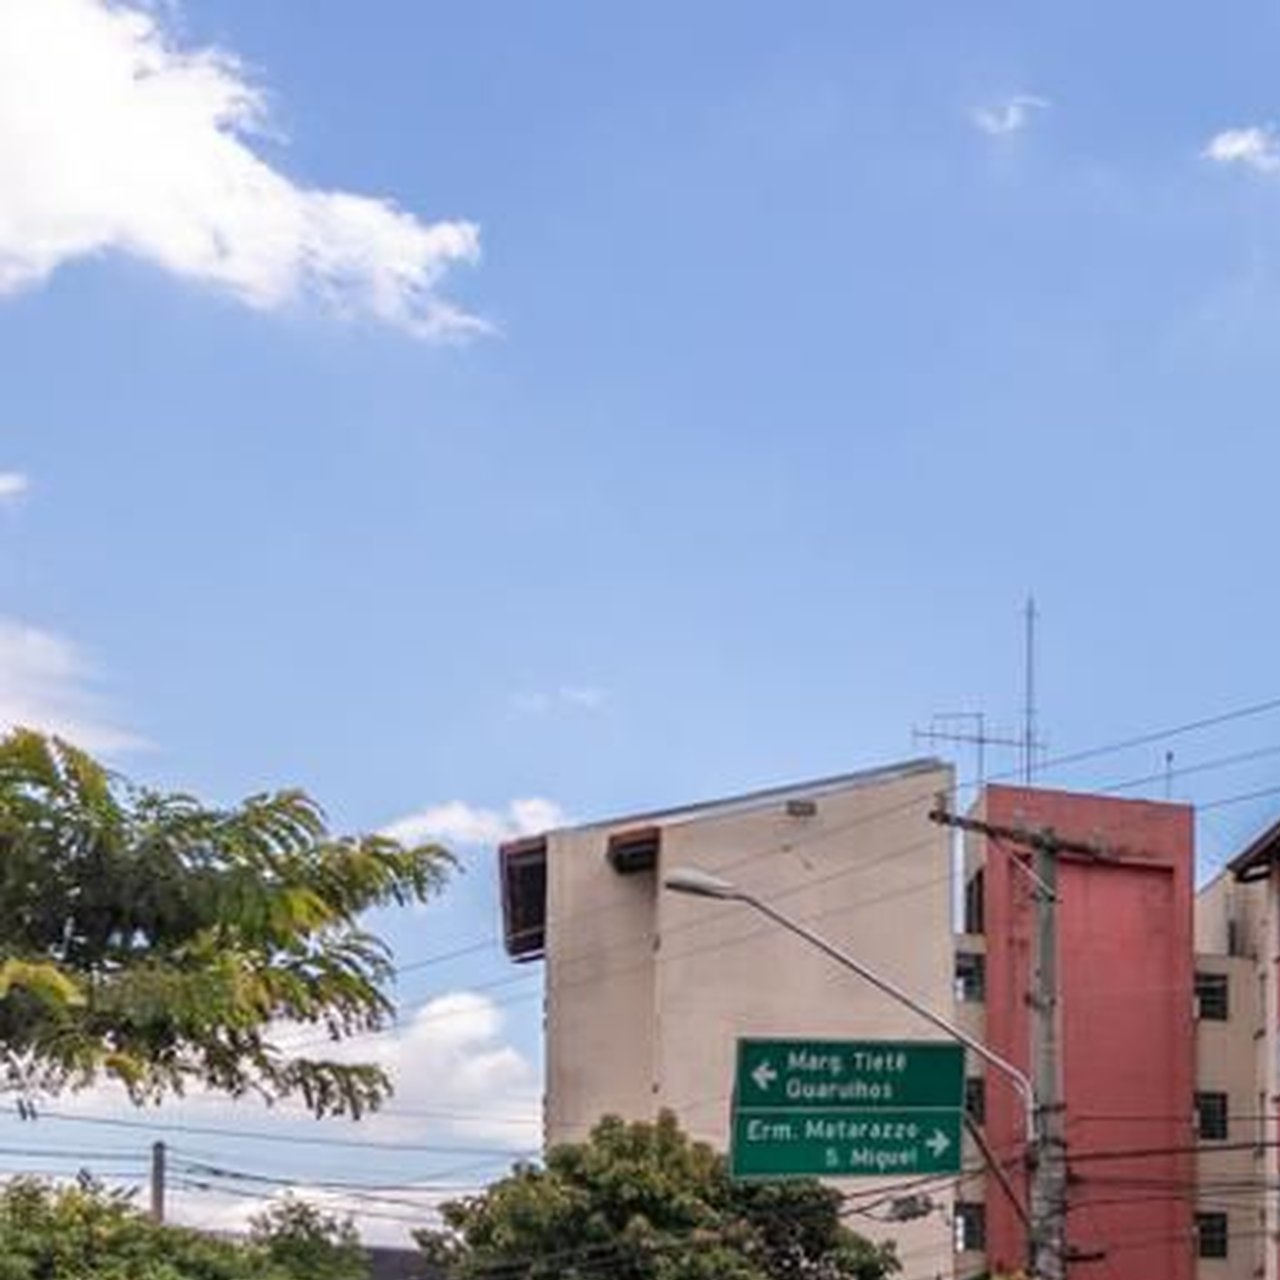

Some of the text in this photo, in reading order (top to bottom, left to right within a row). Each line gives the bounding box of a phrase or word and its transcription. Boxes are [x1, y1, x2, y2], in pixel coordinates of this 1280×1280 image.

[786, 1078, 892, 1099] Guarulhos
[805, 1119, 919, 1139] Matarazzo
[850, 1147, 918, 1170] Miguel
